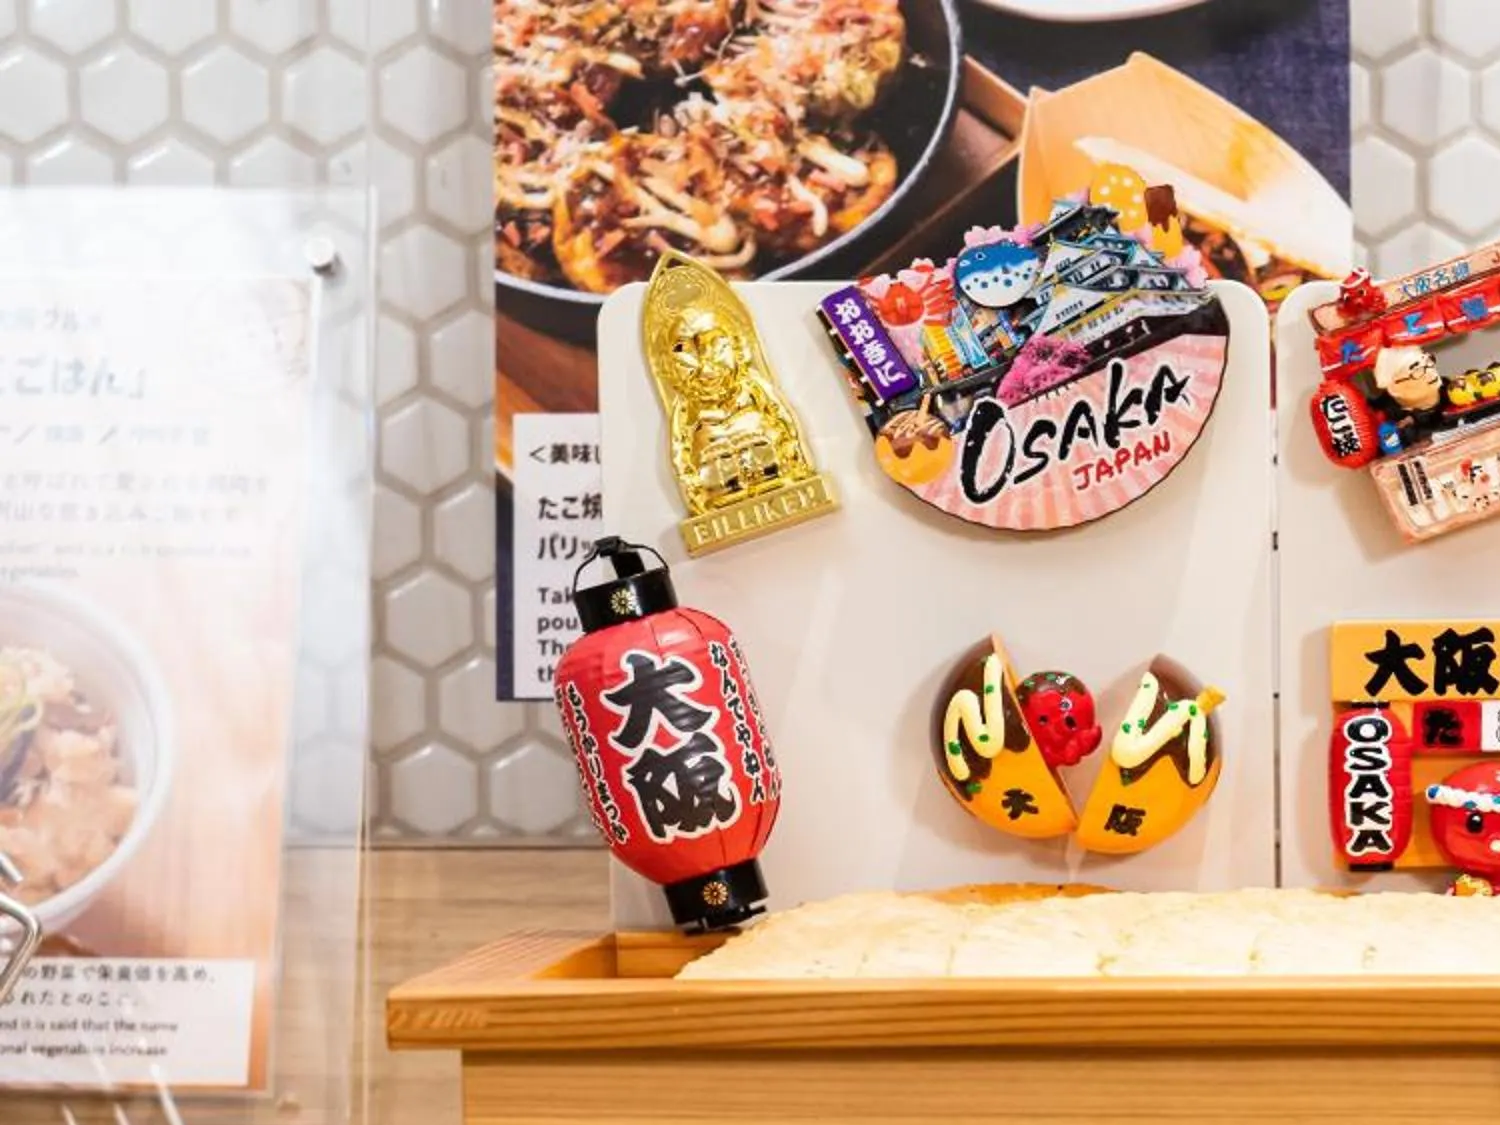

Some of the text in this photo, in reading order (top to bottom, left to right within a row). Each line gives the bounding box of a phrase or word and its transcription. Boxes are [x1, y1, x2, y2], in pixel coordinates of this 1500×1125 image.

[1073, 431, 1172, 491] JAPAN
[601, 649, 740, 842] 大阪
[707, 641, 766, 805] なんでやねん
[1344, 715, 1394, 855] OSAKA
